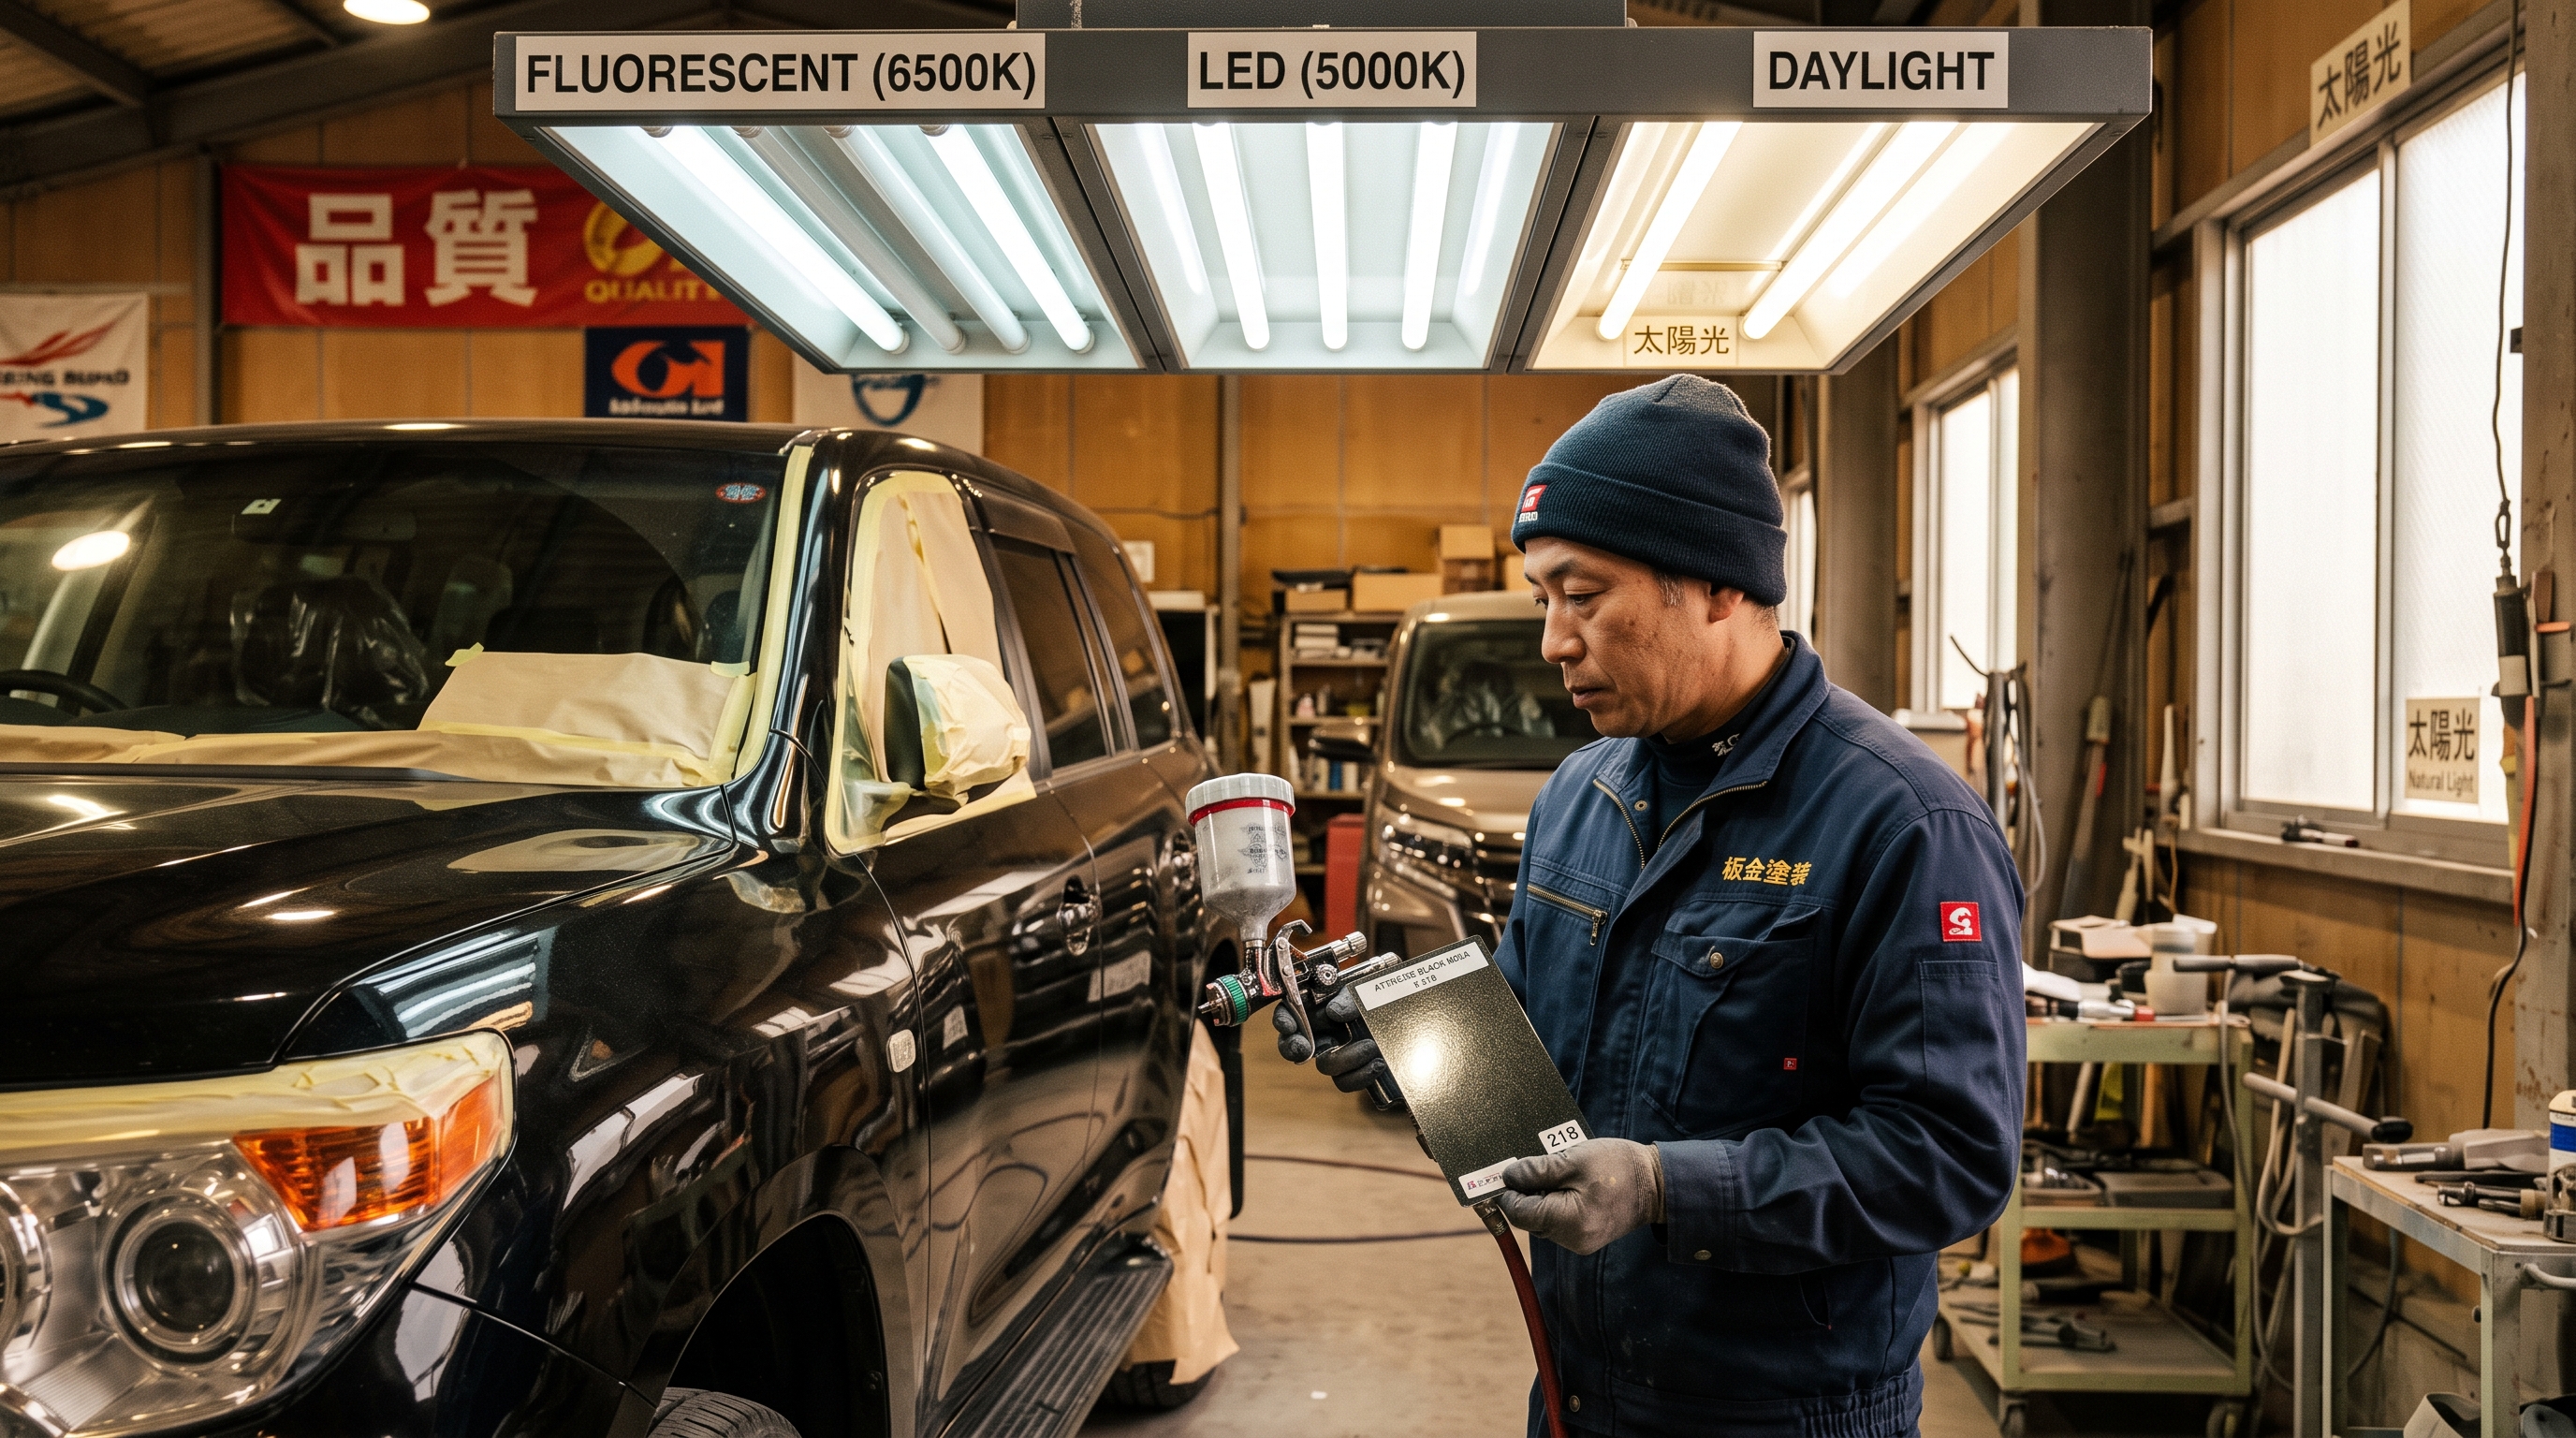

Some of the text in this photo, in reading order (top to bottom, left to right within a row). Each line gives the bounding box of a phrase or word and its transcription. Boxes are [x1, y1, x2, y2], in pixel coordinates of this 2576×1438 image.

[528, 51, 1036, 101] FLUORESCENT (6500K)
[1200, 51, 1465, 99] LED (5000K)
[1769, 51, 1995, 90] DAYLIGHT
[2317, 21, 2401, 129] 太陽光
[295, 189, 538, 307] 品質
[1633, 325, 1730, 355] 太陽光
[2408, 708, 2475, 761] 太陽光
[2408, 770, 2474, 798] Natural Light
[1721, 856, 1812, 887] 板金塗装
[1546, 1126, 1579, 1147] 218
